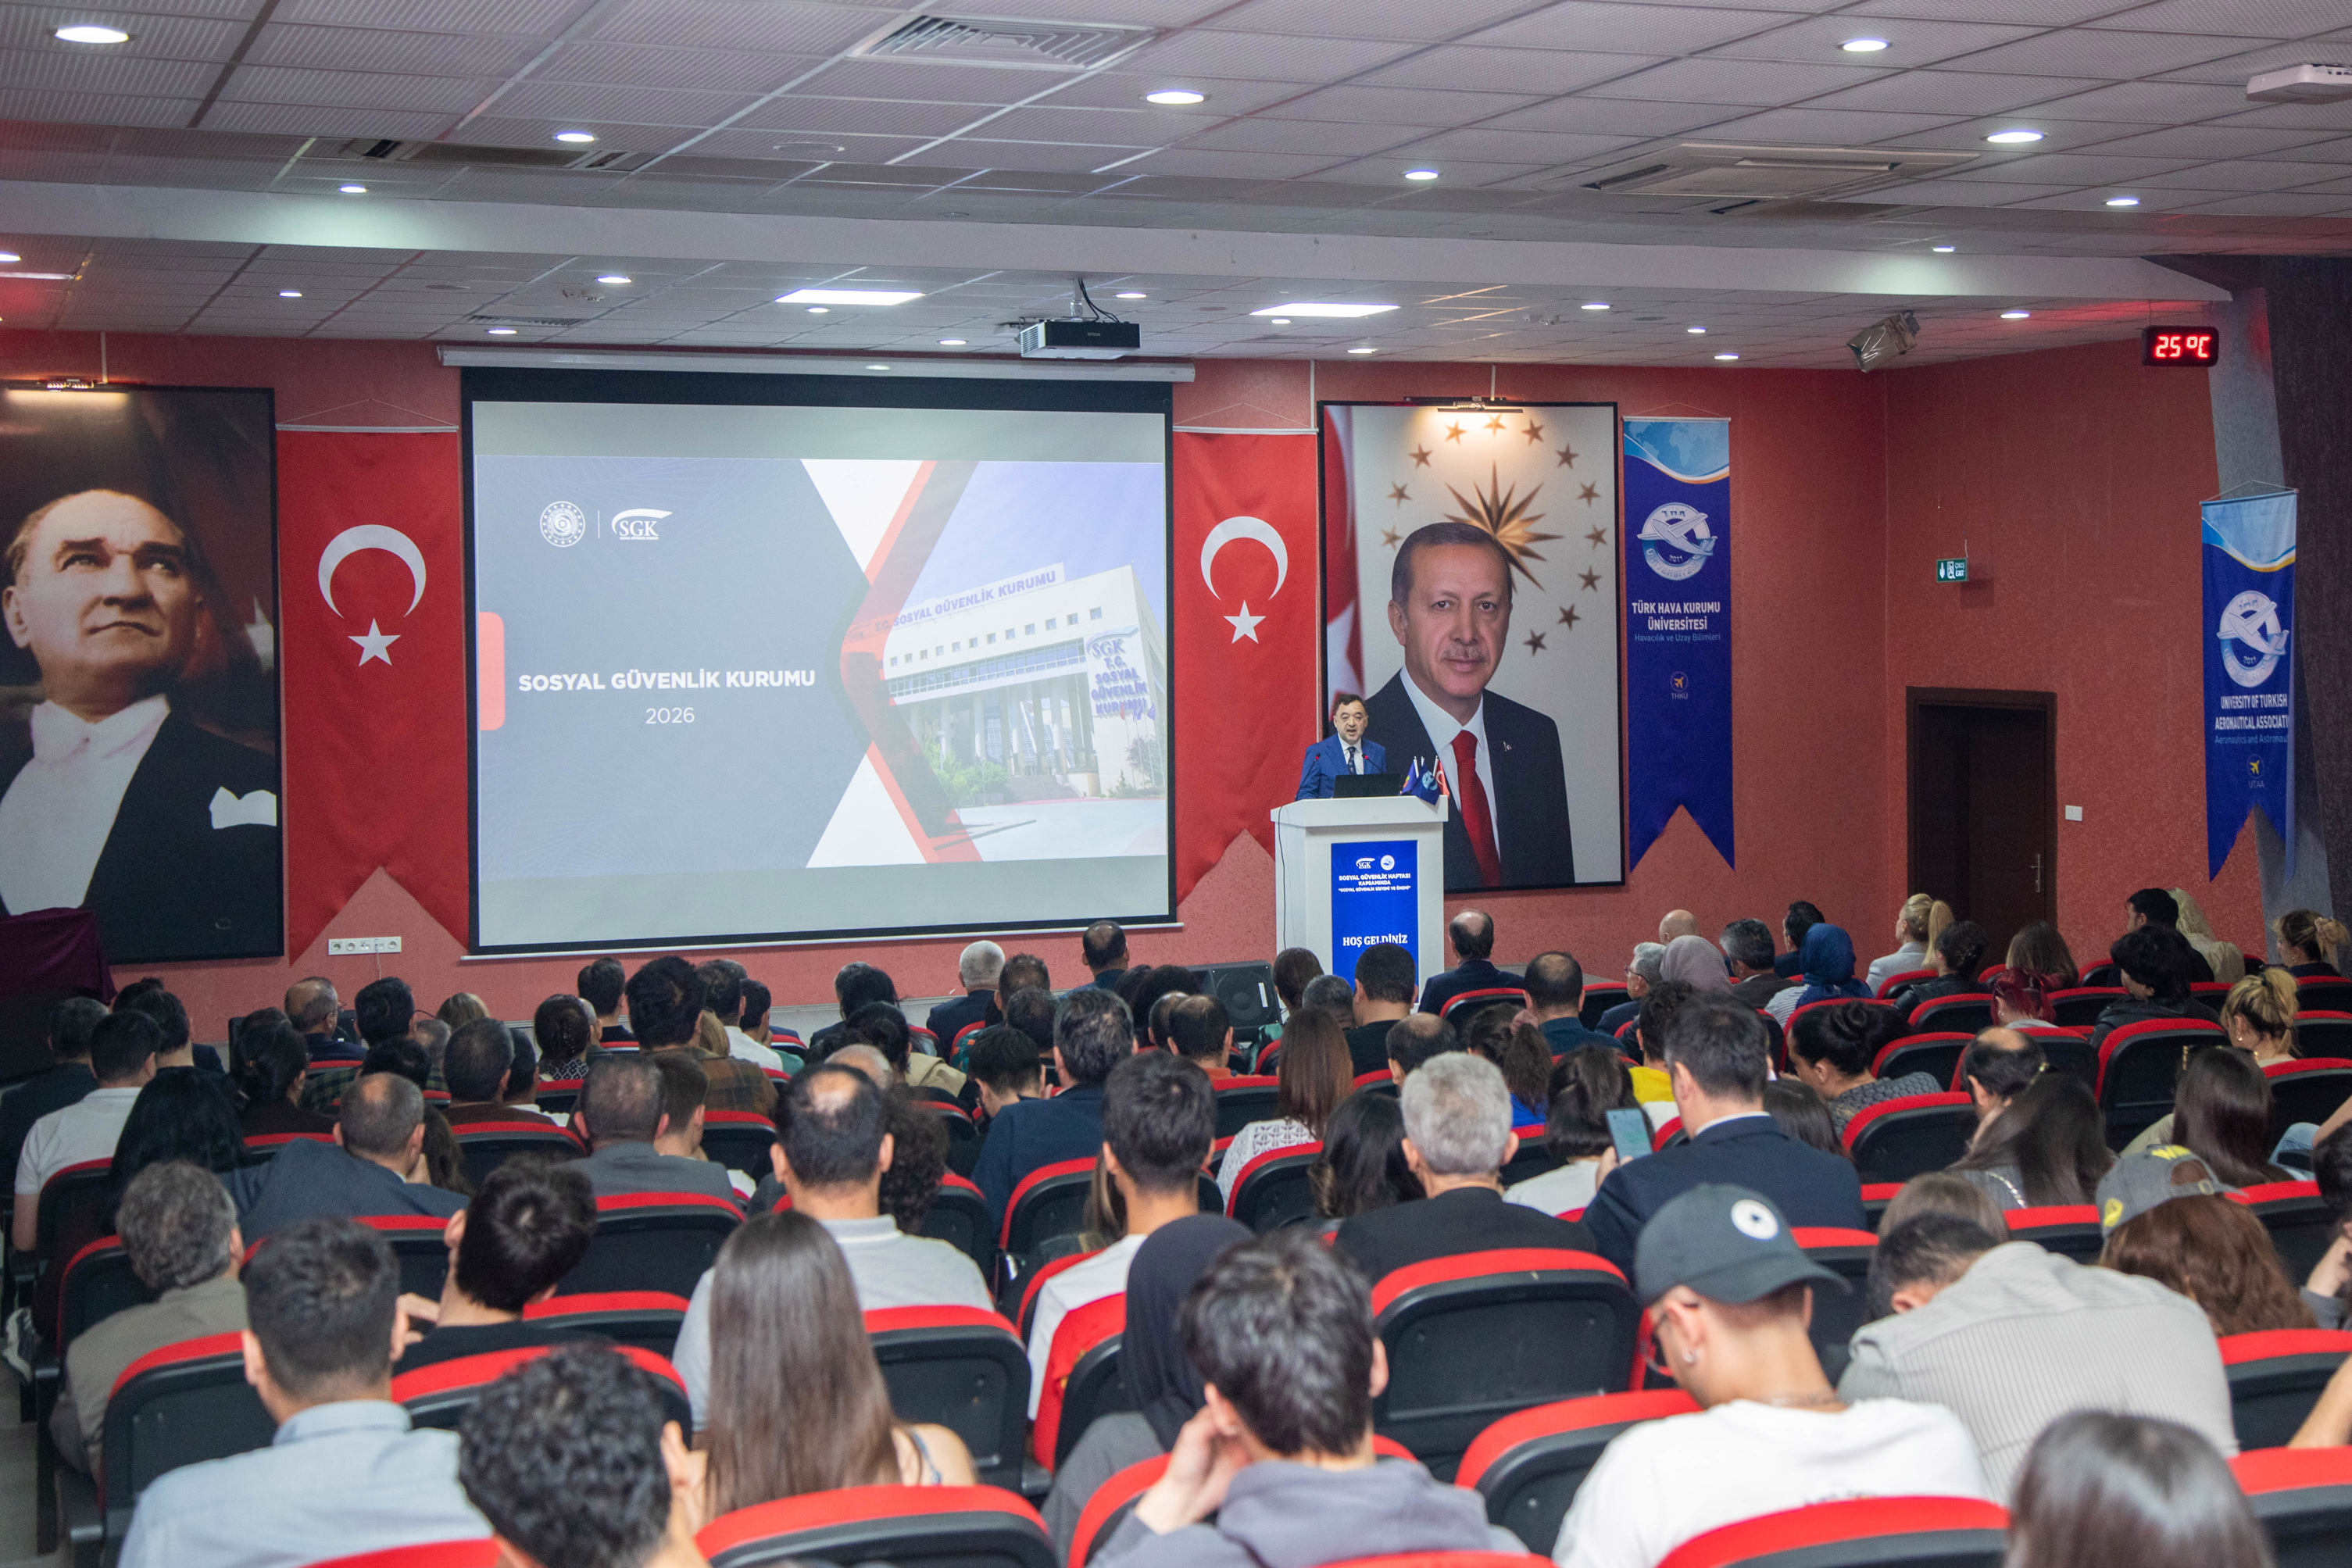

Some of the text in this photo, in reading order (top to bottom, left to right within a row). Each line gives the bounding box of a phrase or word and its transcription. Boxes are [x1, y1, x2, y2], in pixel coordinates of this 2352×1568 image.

[2155, 335, 2182, 358] 25
[619, 520, 659, 537] SGK
[935, 588, 995, 615] GÜVENLİK
[998, 570, 1056, 597] KURUMU
[1632, 599, 1721, 614] TÜRK HAVA KURUMU
[1648, 616, 1707, 630] ÜNİVERSİTESİ
[518, 668, 816, 691] SOSYAL GÜVENLİK KURUMU
[1095, 667, 1139, 684] SOSYAL
[2220, 694, 2288, 709] UNIVERSITY OF TURKISH
[645, 707, 695, 724] 2026
[2215, 716, 2256, 730] AERONAUTICAL
[1342, 937, 1362, 948] HOŞ
